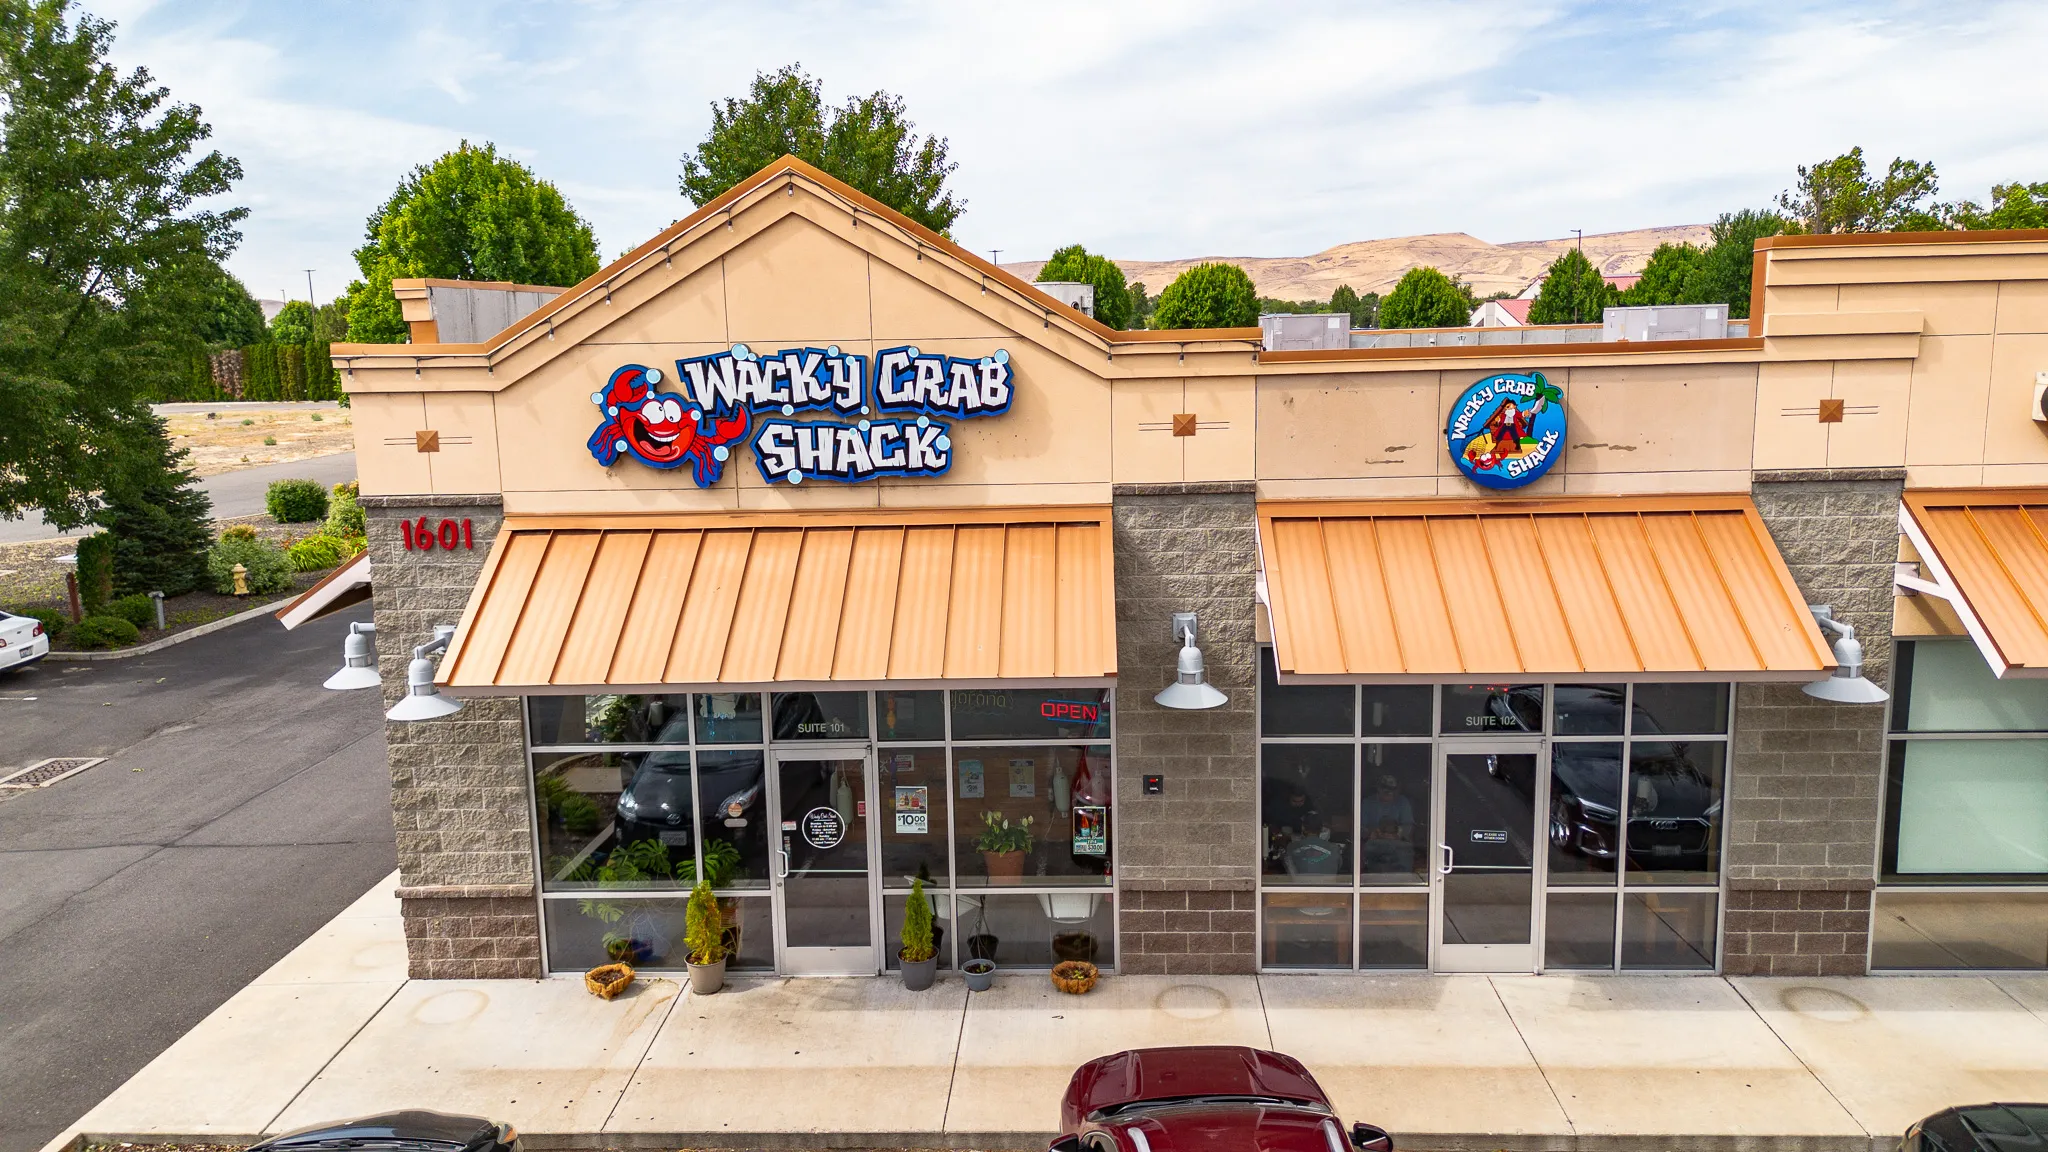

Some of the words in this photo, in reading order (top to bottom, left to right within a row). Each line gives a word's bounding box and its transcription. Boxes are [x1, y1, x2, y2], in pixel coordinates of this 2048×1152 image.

[684, 353, 864, 409] WACKY
[877, 351, 1009, 408] CRAB
[1494, 378, 1536, 397] CRAB
[758, 422, 947, 476] SHACK
[1507, 429, 1559, 477] SHACK
[400, 515, 473, 551] 1601
[1041, 701, 1098, 720] OPEN
[1465, 716, 1496, 726] SUITE
[1500, 716, 1516, 726] 102
[797, 723, 827, 733] SUITE
[830, 723, 845, 732] 101
